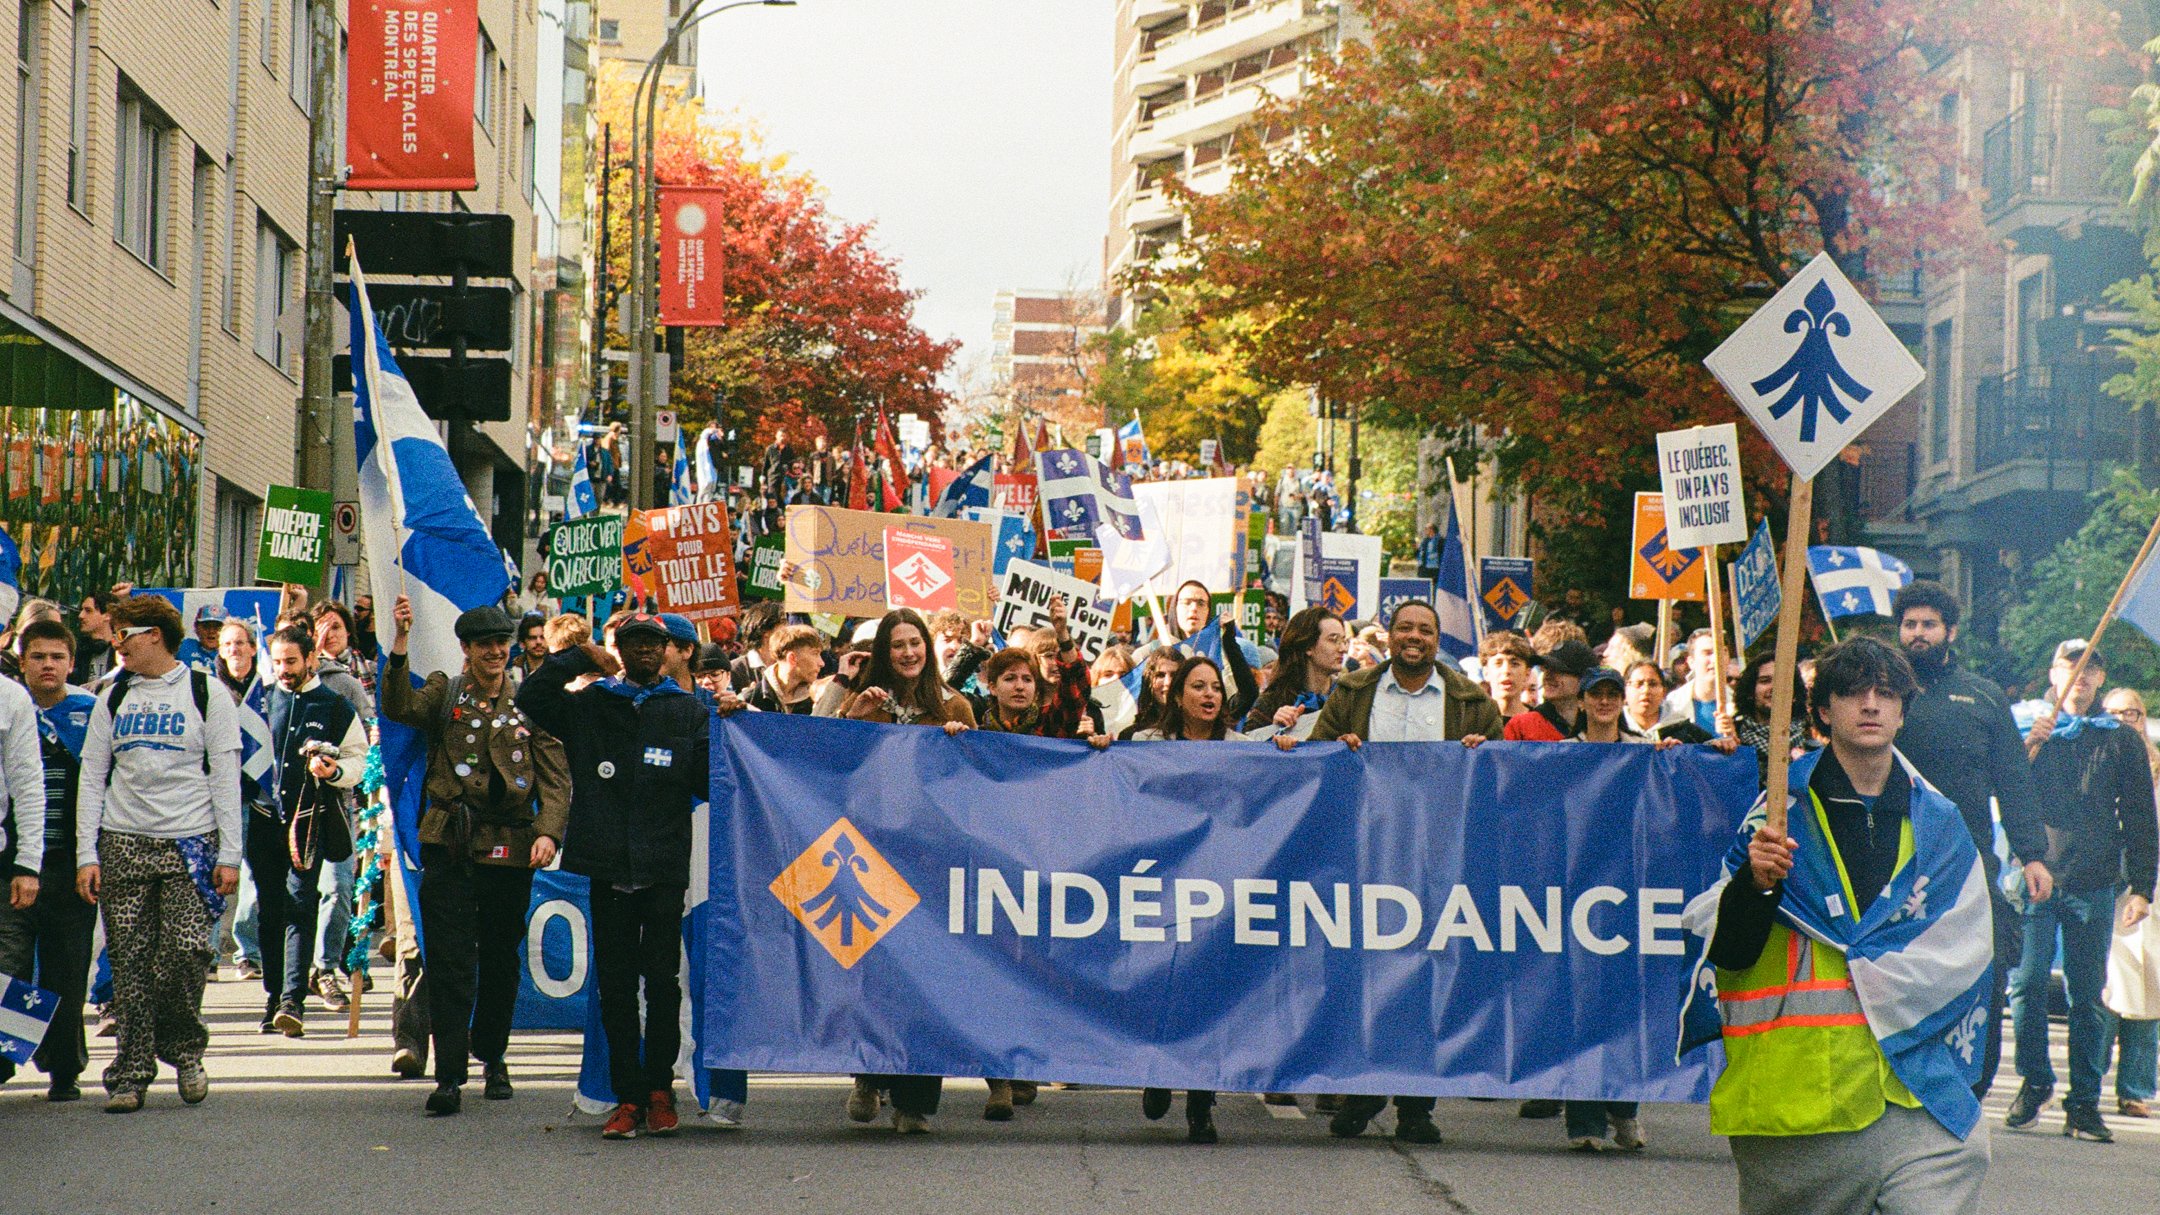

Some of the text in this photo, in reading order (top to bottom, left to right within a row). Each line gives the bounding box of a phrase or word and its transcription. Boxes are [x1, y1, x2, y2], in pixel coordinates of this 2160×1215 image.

[384, 10, 403, 103] MONTRÉAL
[422, 11, 438, 95] QUARTIER
[402, 10, 418, 154] DES SPECTACLES
[1668, 450, 1681, 474] LE
[1676, 472, 1730, 501] UN PAYS
[266, 504, 325, 538] INDÉPEN-
[651, 504, 721, 538] UN PAYS
[1679, 500, 1730, 528] INCLUSIF
[677, 540, 703, 556] POUR
[791, 506, 884, 561] Québe
[657, 552, 727, 584] TOUT LE
[755, 545, 785, 568] QUÉBE
[666, 578, 726, 607] MONDE
[948, 860, 1686, 957] INDÉPENDANCE
